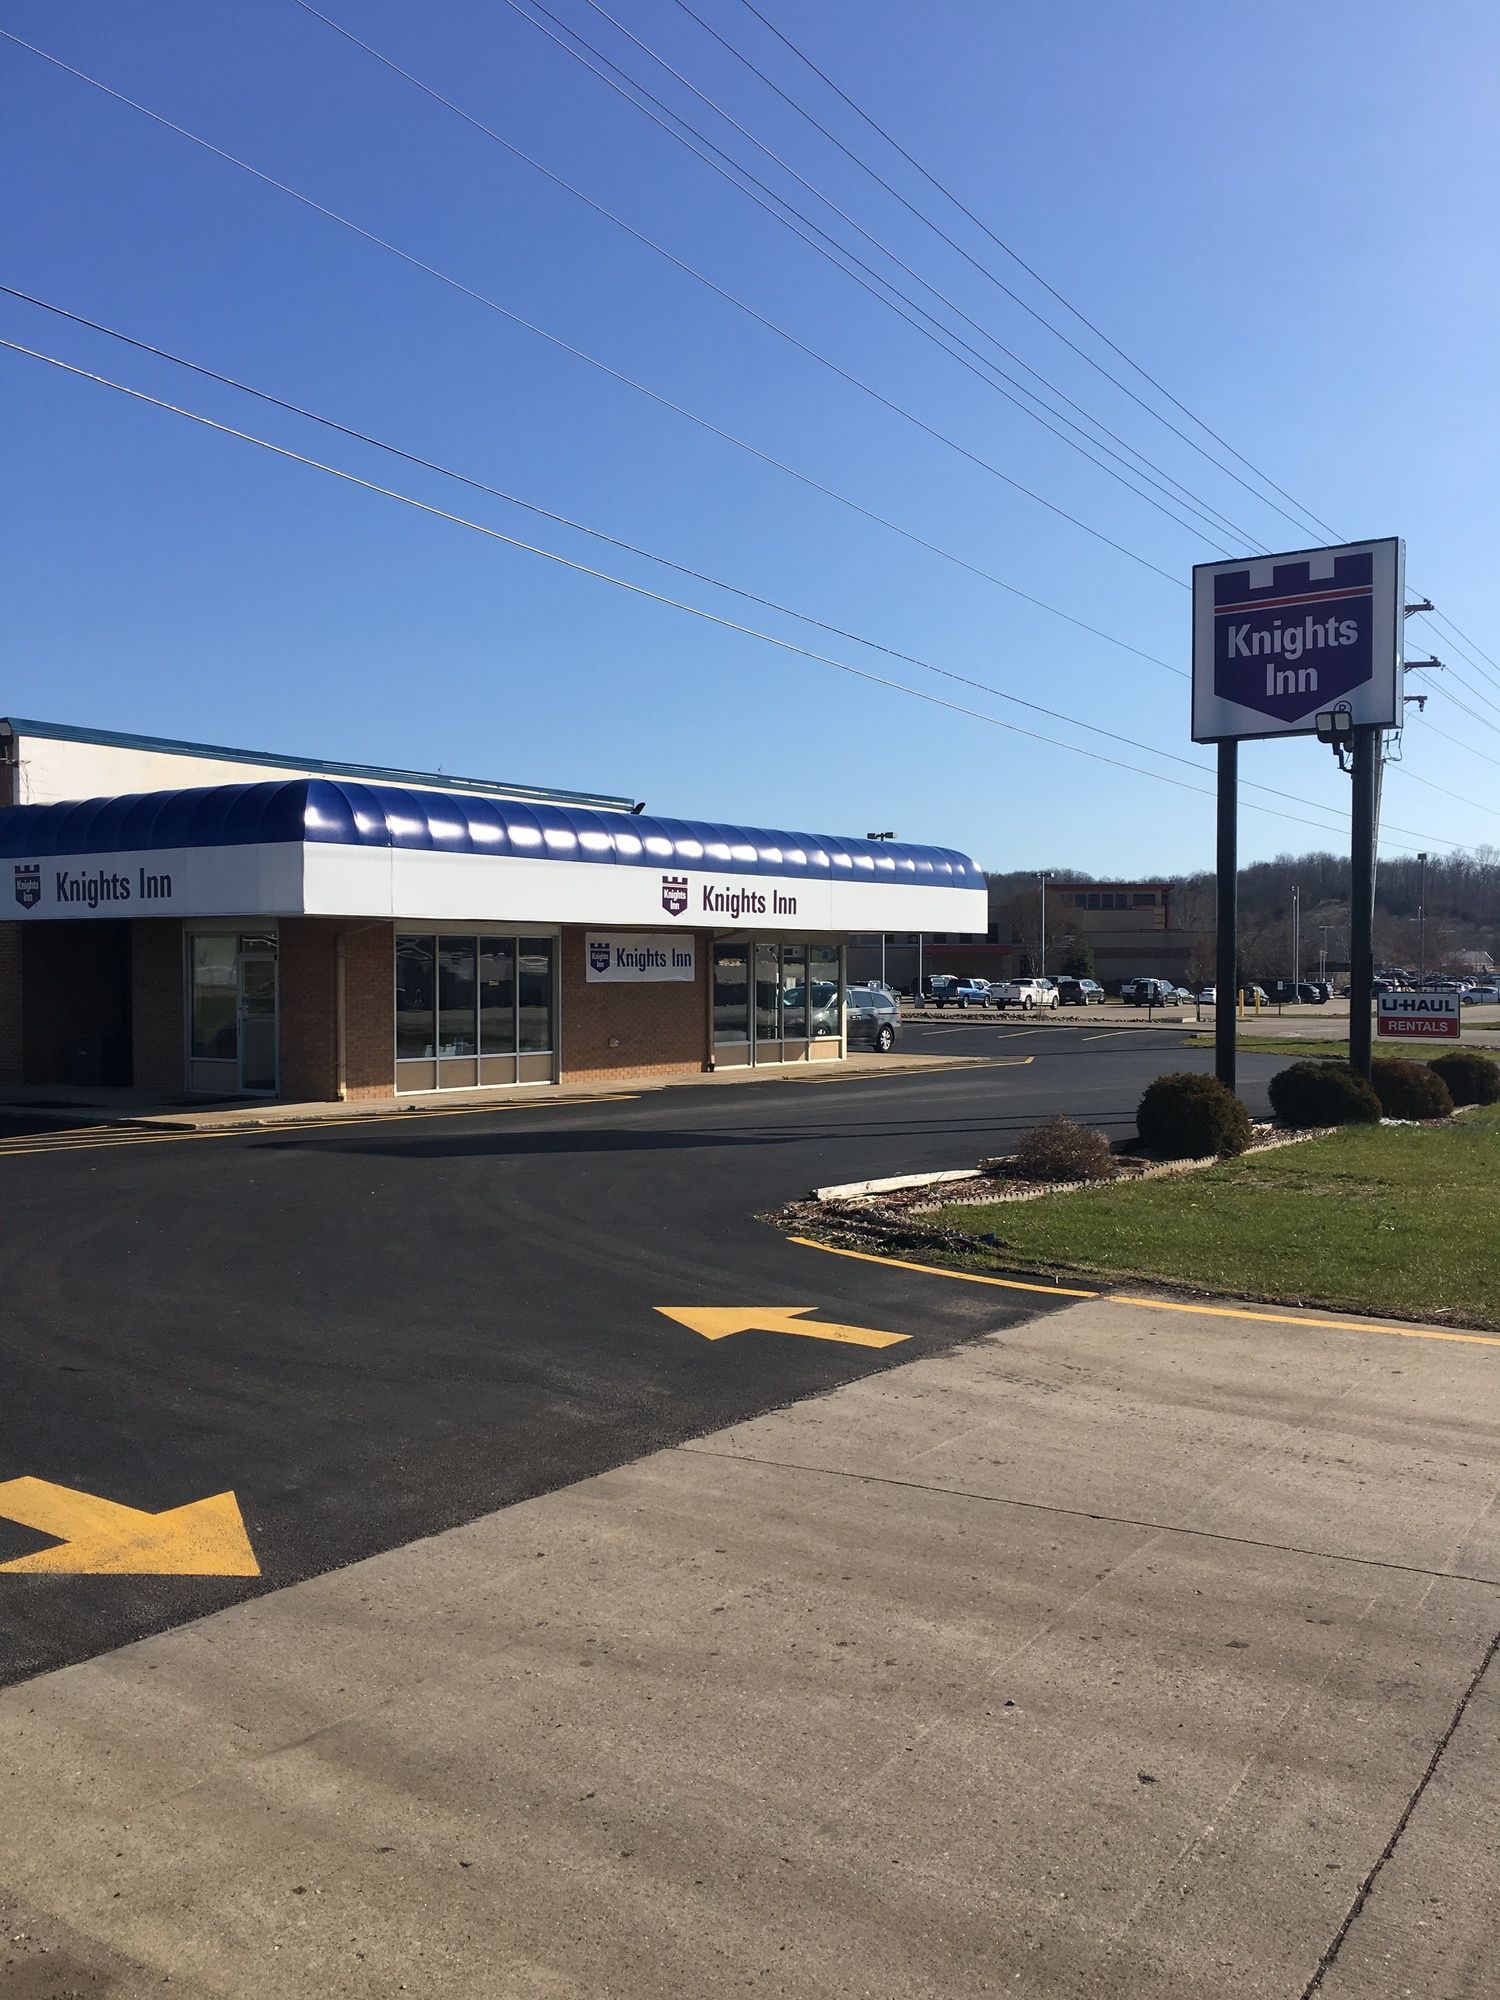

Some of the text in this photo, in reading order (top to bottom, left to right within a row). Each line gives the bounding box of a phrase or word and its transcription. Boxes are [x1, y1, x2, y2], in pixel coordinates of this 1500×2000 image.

[1228, 616, 1358, 659] Knights
[1266, 663, 1318, 696] Inn
[56, 868, 172, 909] Knights Inn
[664, 888, 686, 901] Knights
[703, 885, 797, 919] Knights Inn
[616, 947, 692, 972] Knights Inn
[1382, 999, 1455, 1012] U-HAUL
[1388, 1021, 1449, 1032] RENTALS
